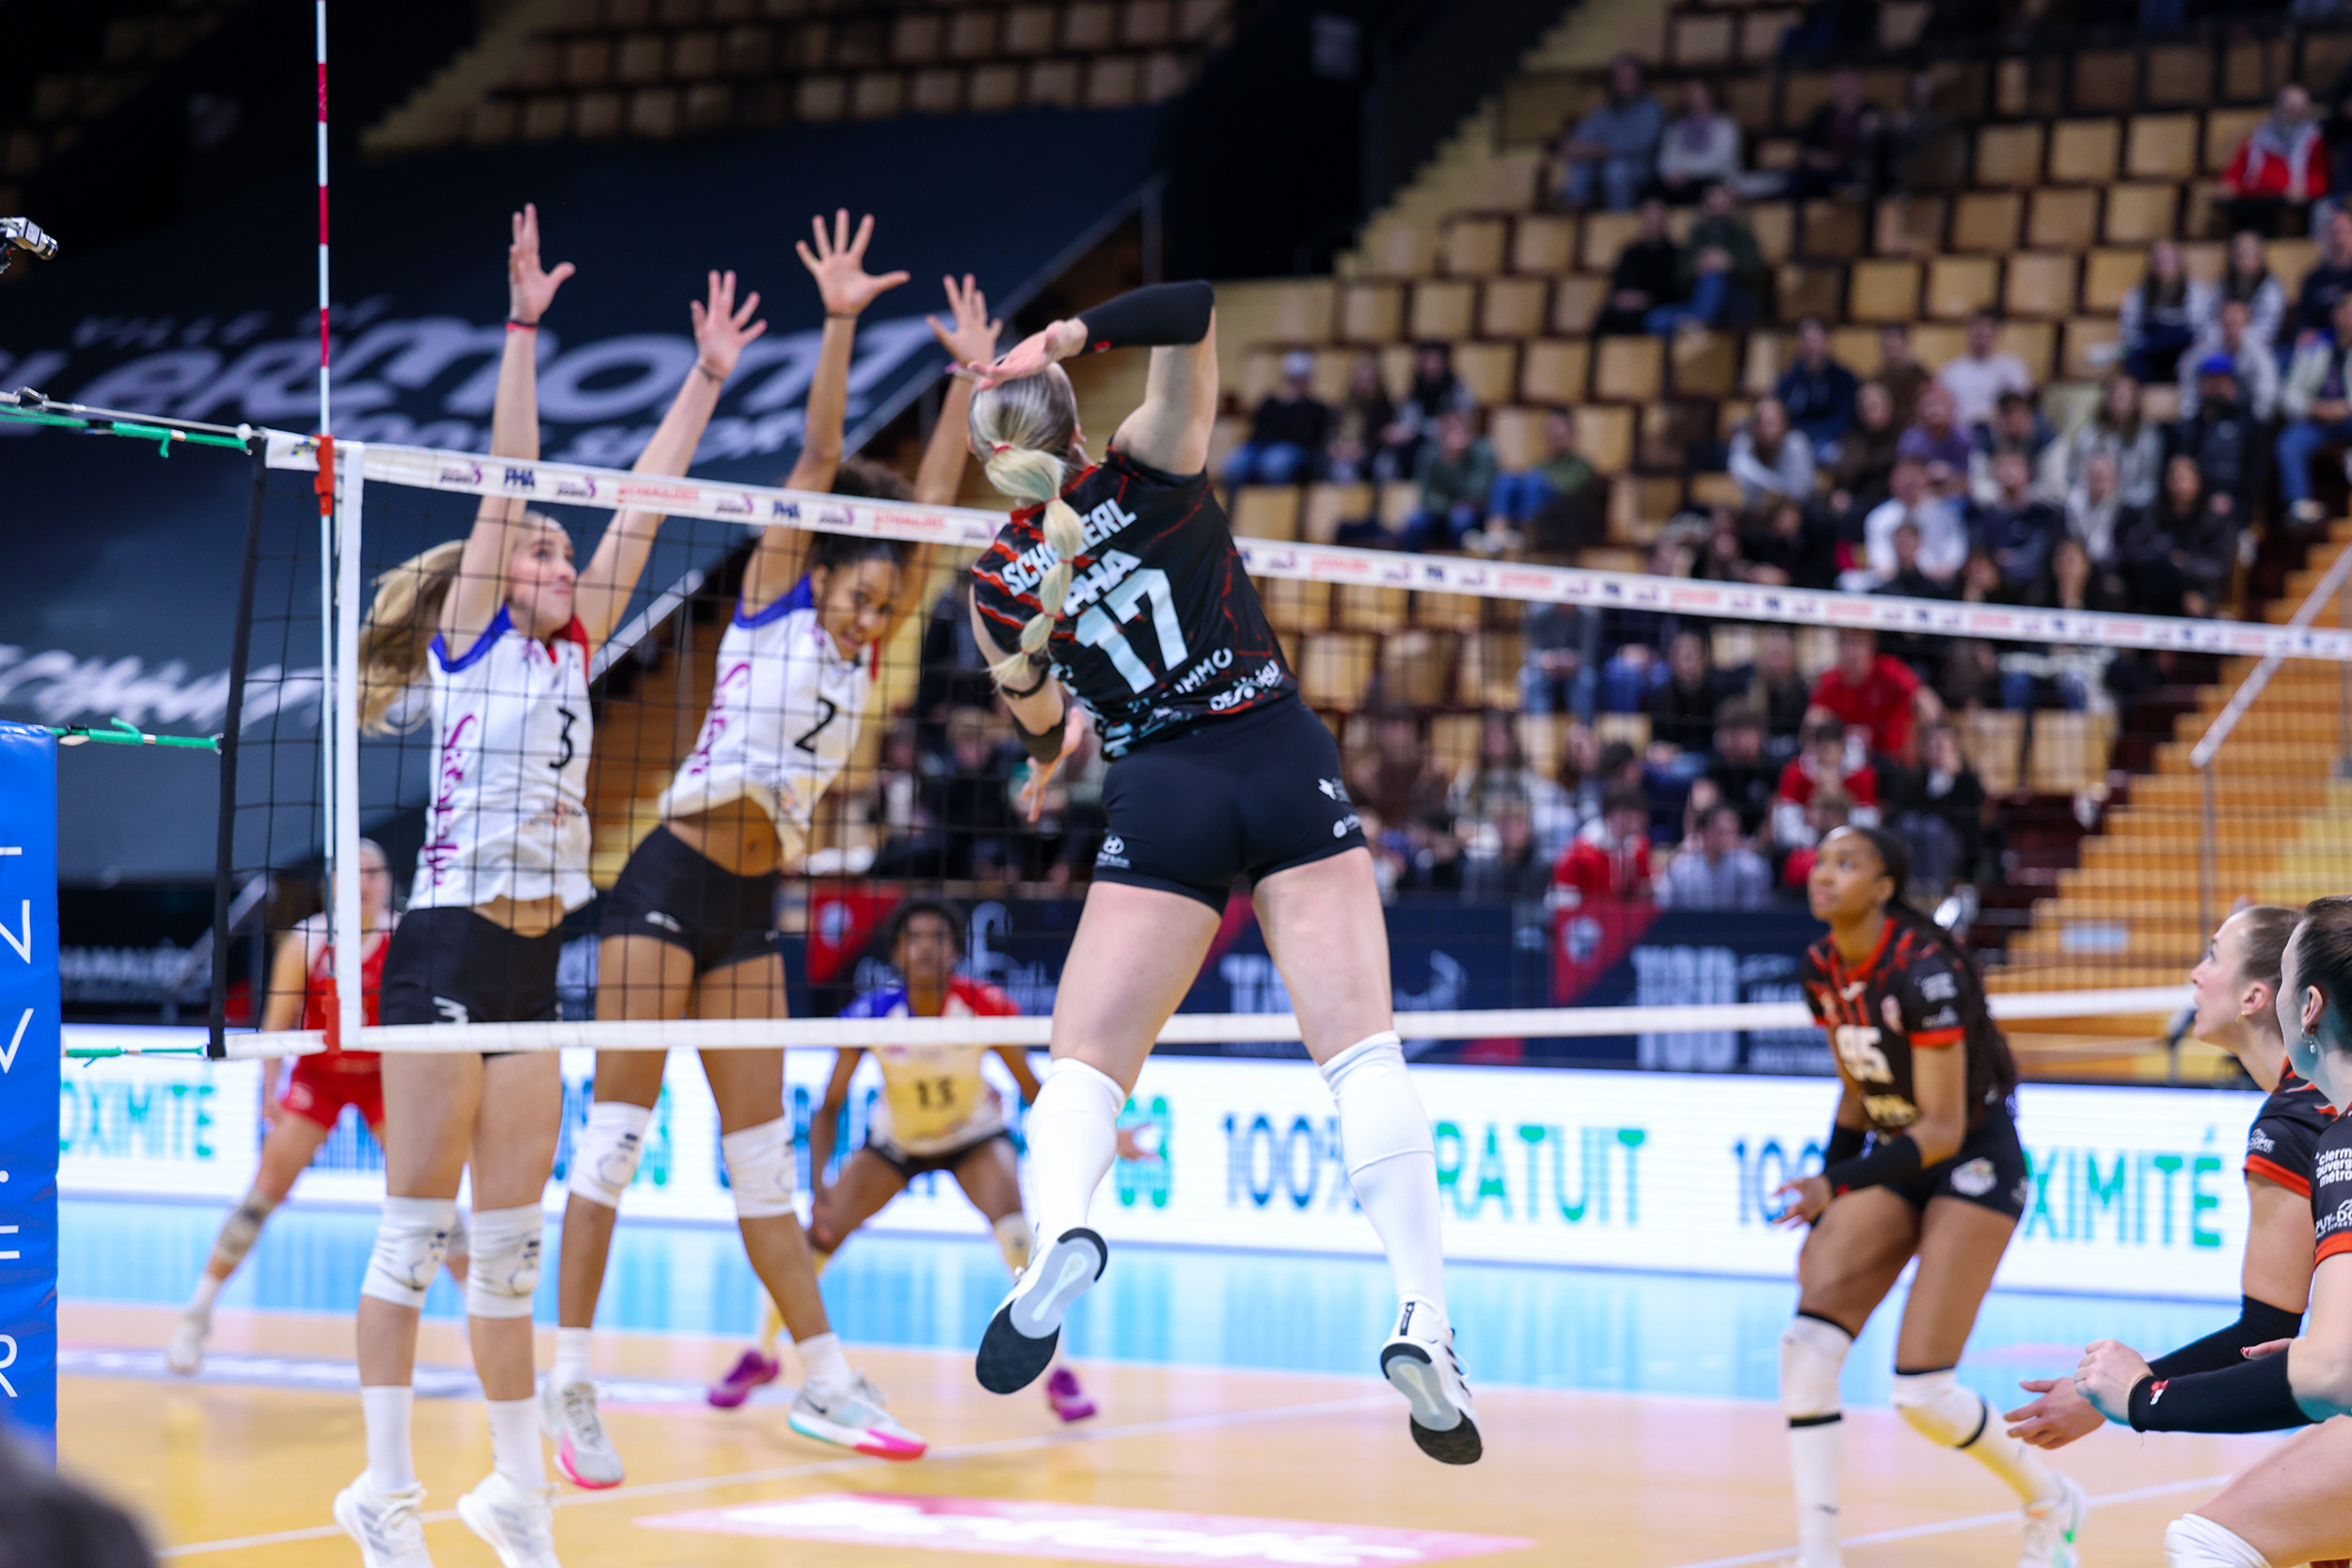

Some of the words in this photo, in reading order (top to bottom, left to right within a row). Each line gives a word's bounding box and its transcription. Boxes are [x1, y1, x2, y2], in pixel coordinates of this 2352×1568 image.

[1002, 498, 1137, 597] SCHERL
[1062, 548, 1142, 617] PHA
[1074, 568, 1188, 694] 17
[548, 706, 578, 769] 3
[795, 696, 836, 752] 2
[1436, 1120, 1645, 1225] RATUIT
[2023, 1125, 2221, 1247] XIMITÉ
